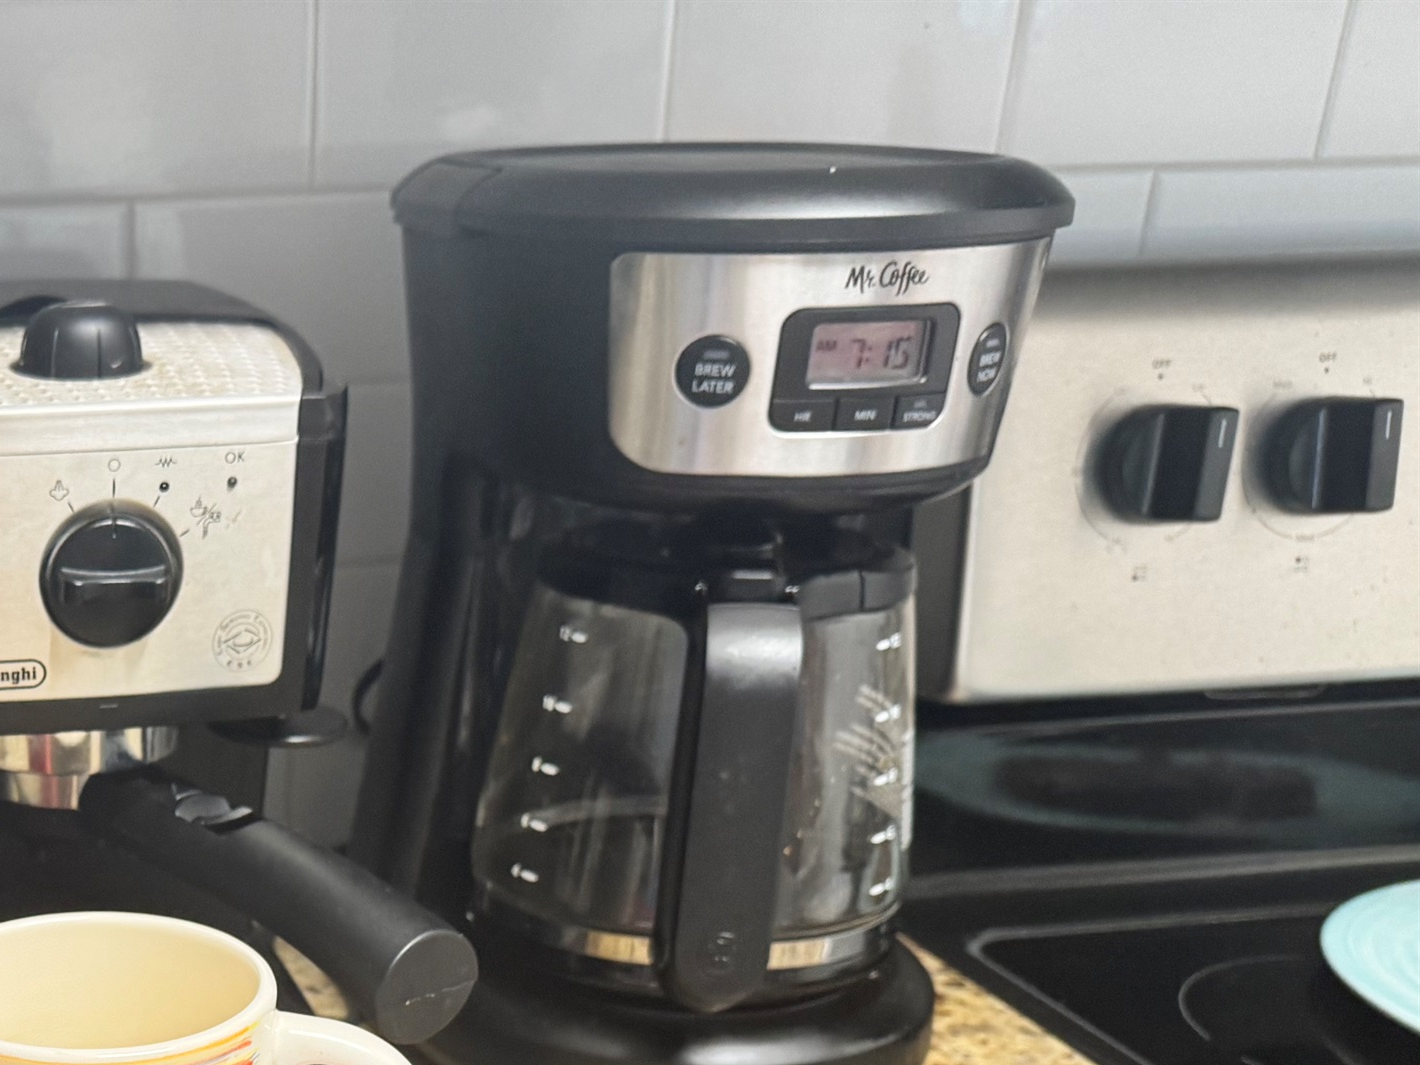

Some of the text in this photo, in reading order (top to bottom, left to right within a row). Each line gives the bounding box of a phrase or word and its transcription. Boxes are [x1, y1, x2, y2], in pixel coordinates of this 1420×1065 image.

[844, 259, 930, 297] Mr. Coffee
[850, 336, 912, 370] 7:15
[694, 362, 737, 378] BREW
[691, 379, 735, 394] LATER
[854, 409, 877, 421] MIN
[224, 451, 245, 464] OK
